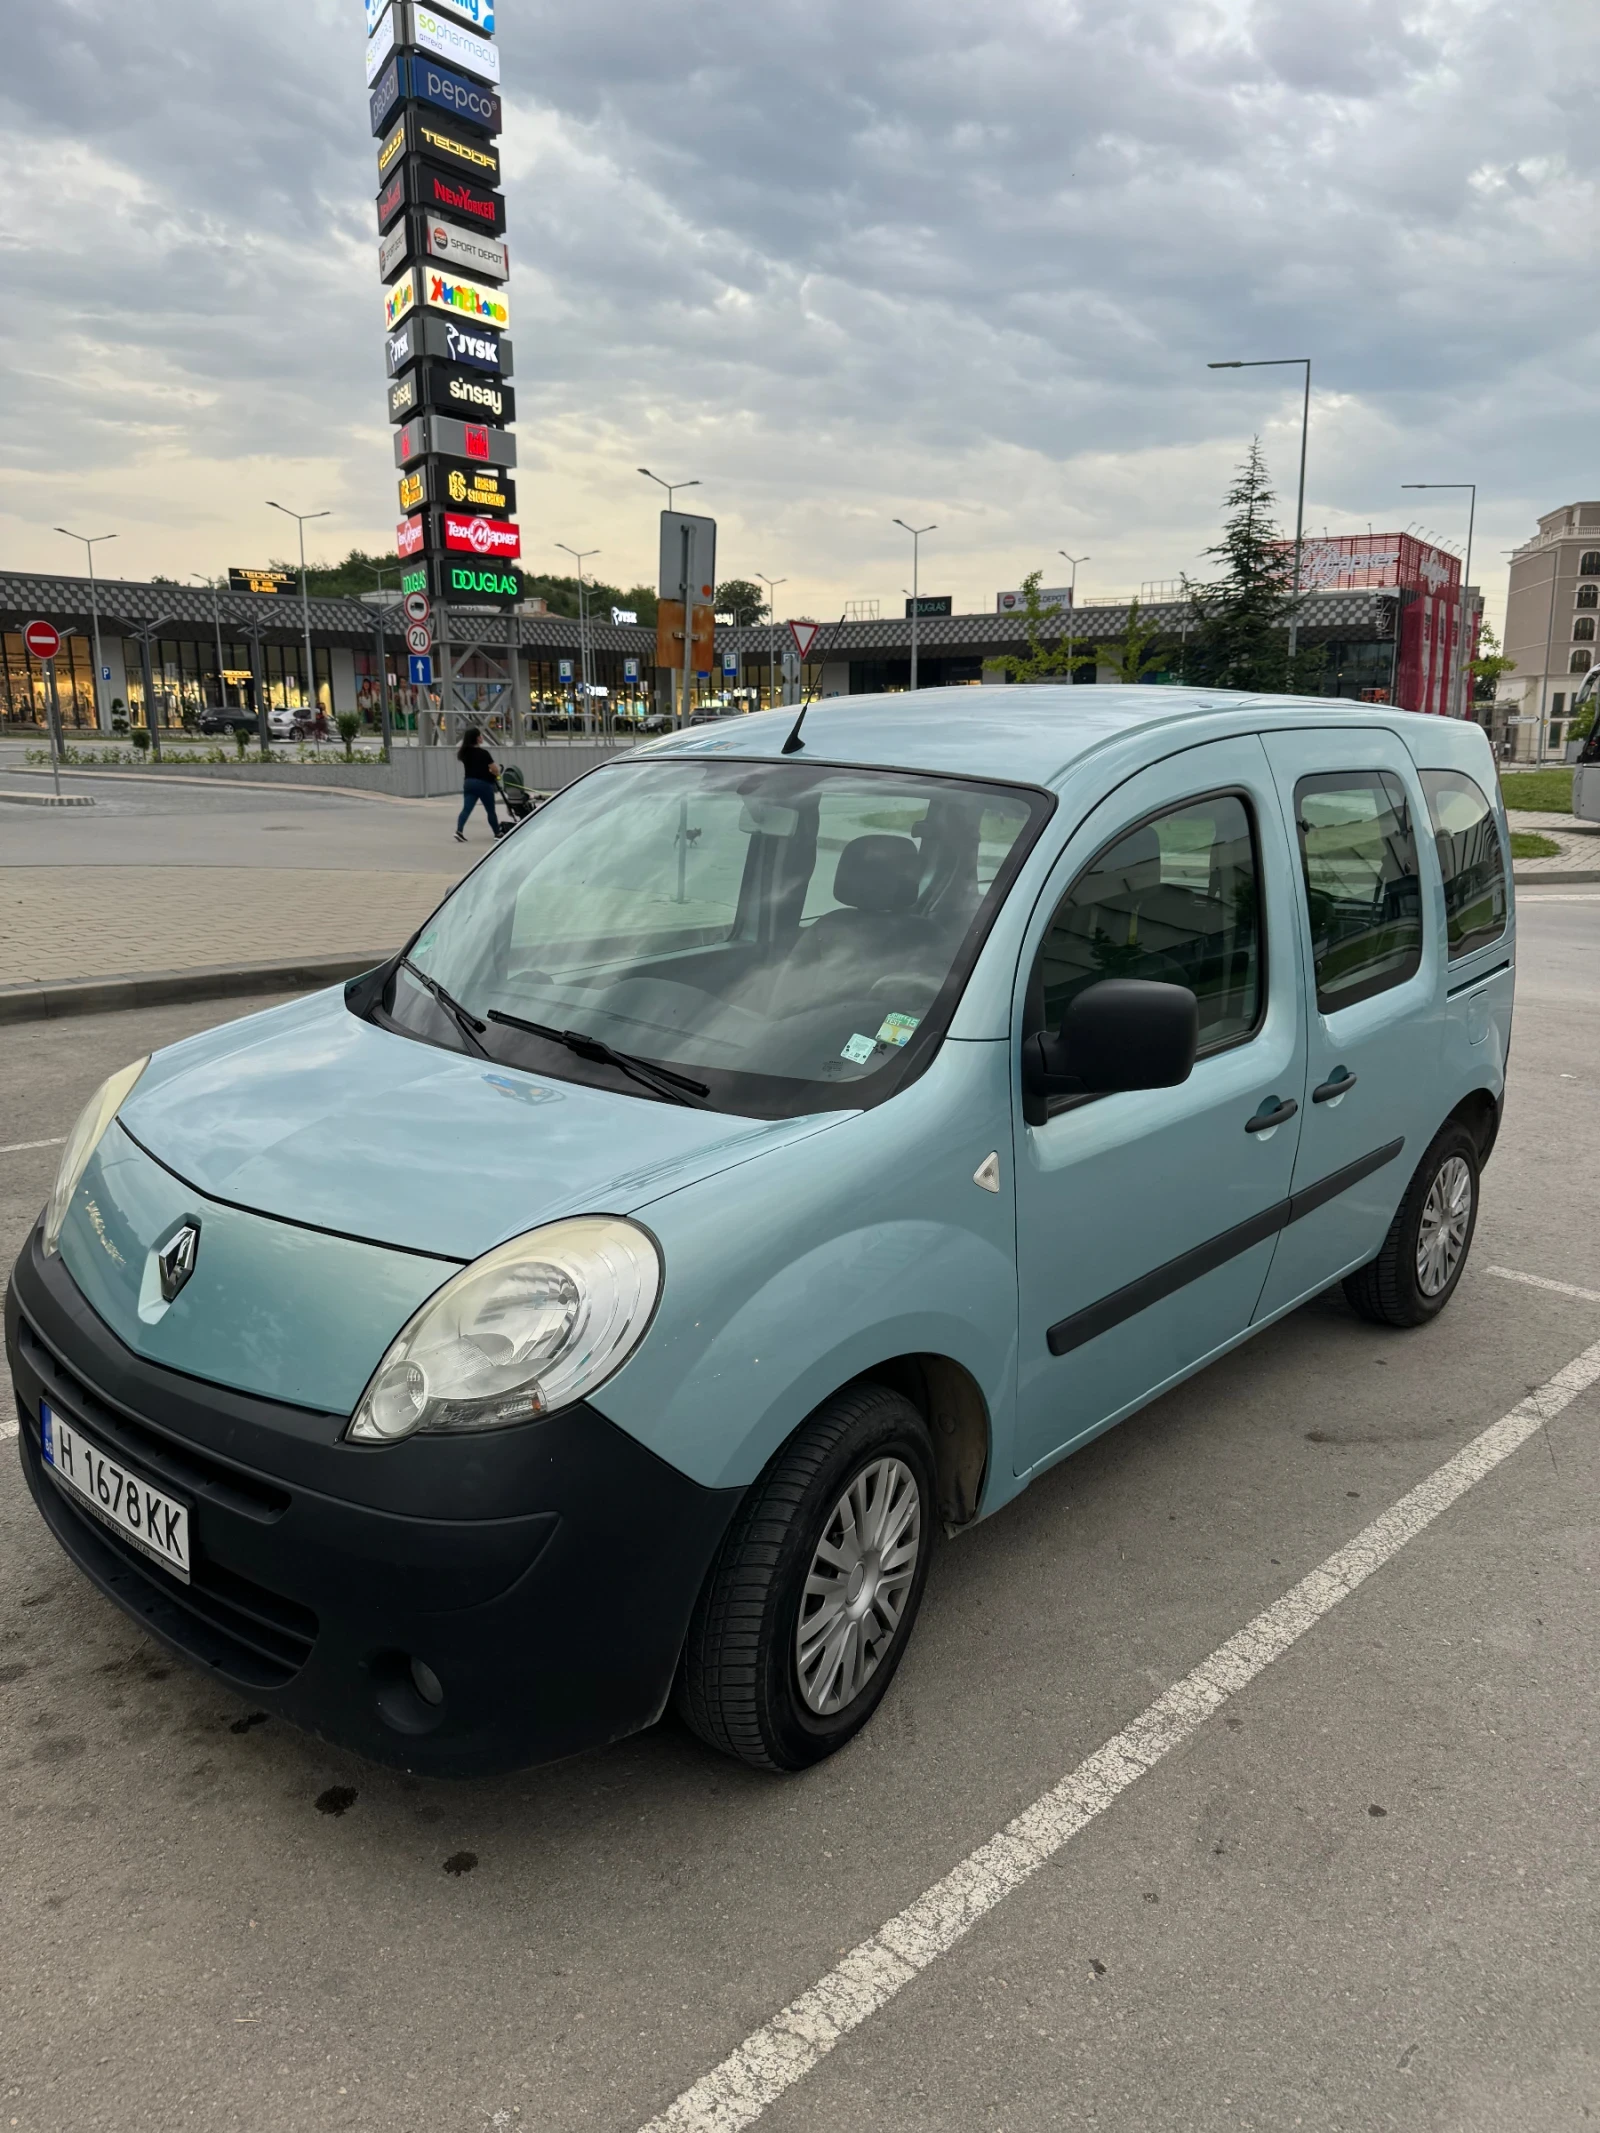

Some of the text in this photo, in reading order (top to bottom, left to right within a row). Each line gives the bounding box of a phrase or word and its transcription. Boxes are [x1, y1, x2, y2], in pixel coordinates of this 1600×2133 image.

[418, 14, 496, 68] sopharmacy
[450, 238, 503, 265] SPORT DEPOT
[457, 334, 498, 363] JYSK
[449, 377, 502, 415] sinsay
[452, 569, 517, 595] DOUGLAS
[412, 631, 426, 647] 20
[59, 1425, 73, 1477] H
